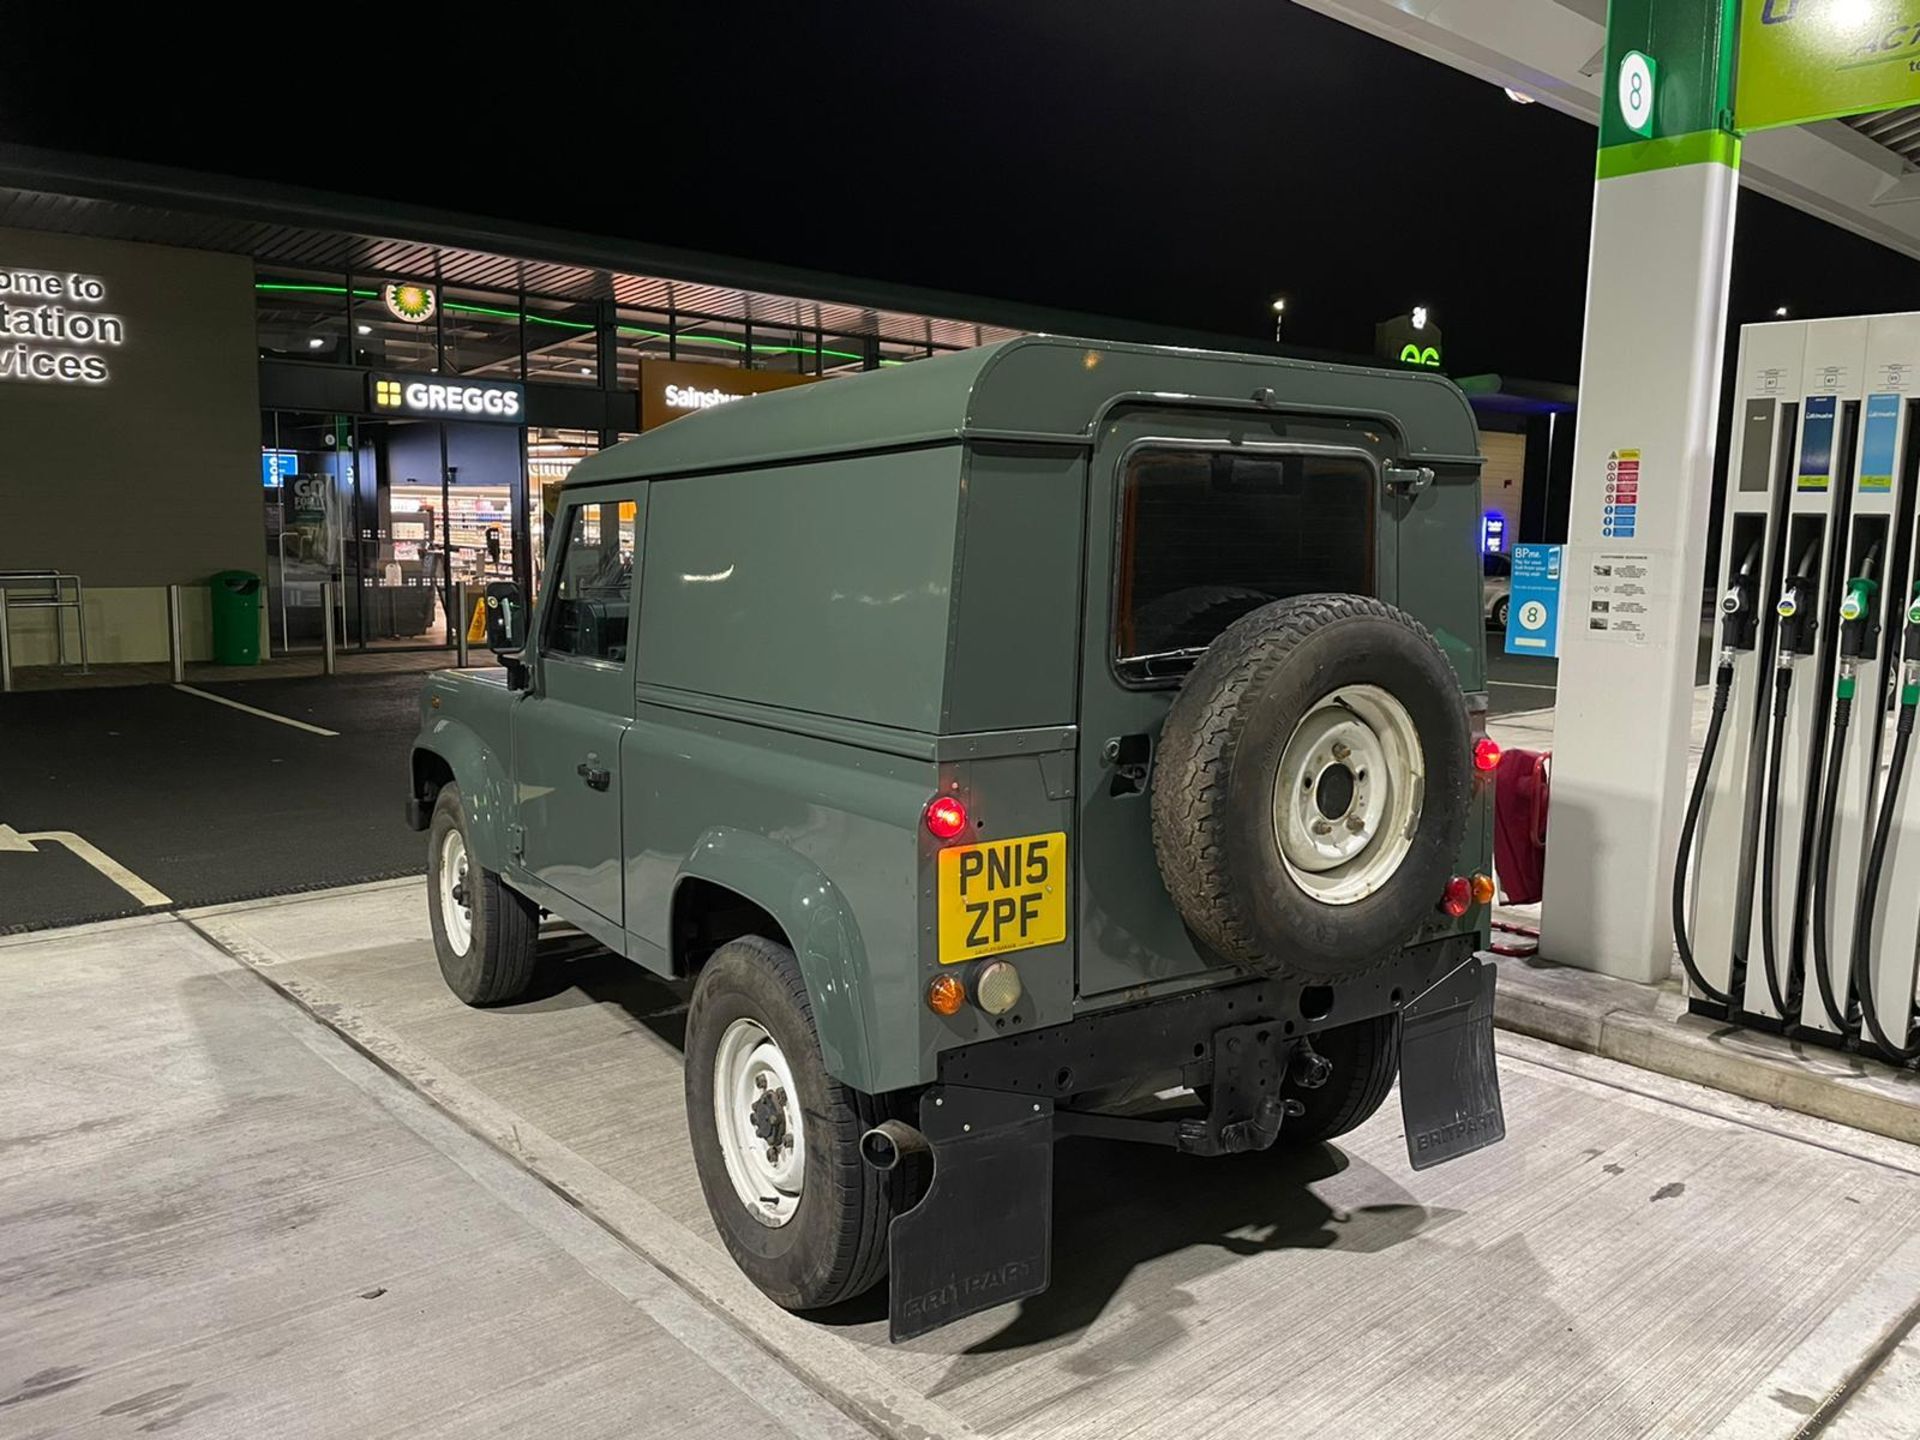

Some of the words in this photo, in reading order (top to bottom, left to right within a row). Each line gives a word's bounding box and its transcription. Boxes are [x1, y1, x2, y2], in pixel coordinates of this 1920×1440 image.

[1630, 72, 1642, 110] 8
[71, 274, 104, 300] to
[0, 304, 123, 342] tation
[405, 383, 520, 416] GREGGS
[1527, 607, 1538, 623] 8
[960, 840, 1049, 896] PN15
[966, 893, 1043, 948] ZPF
